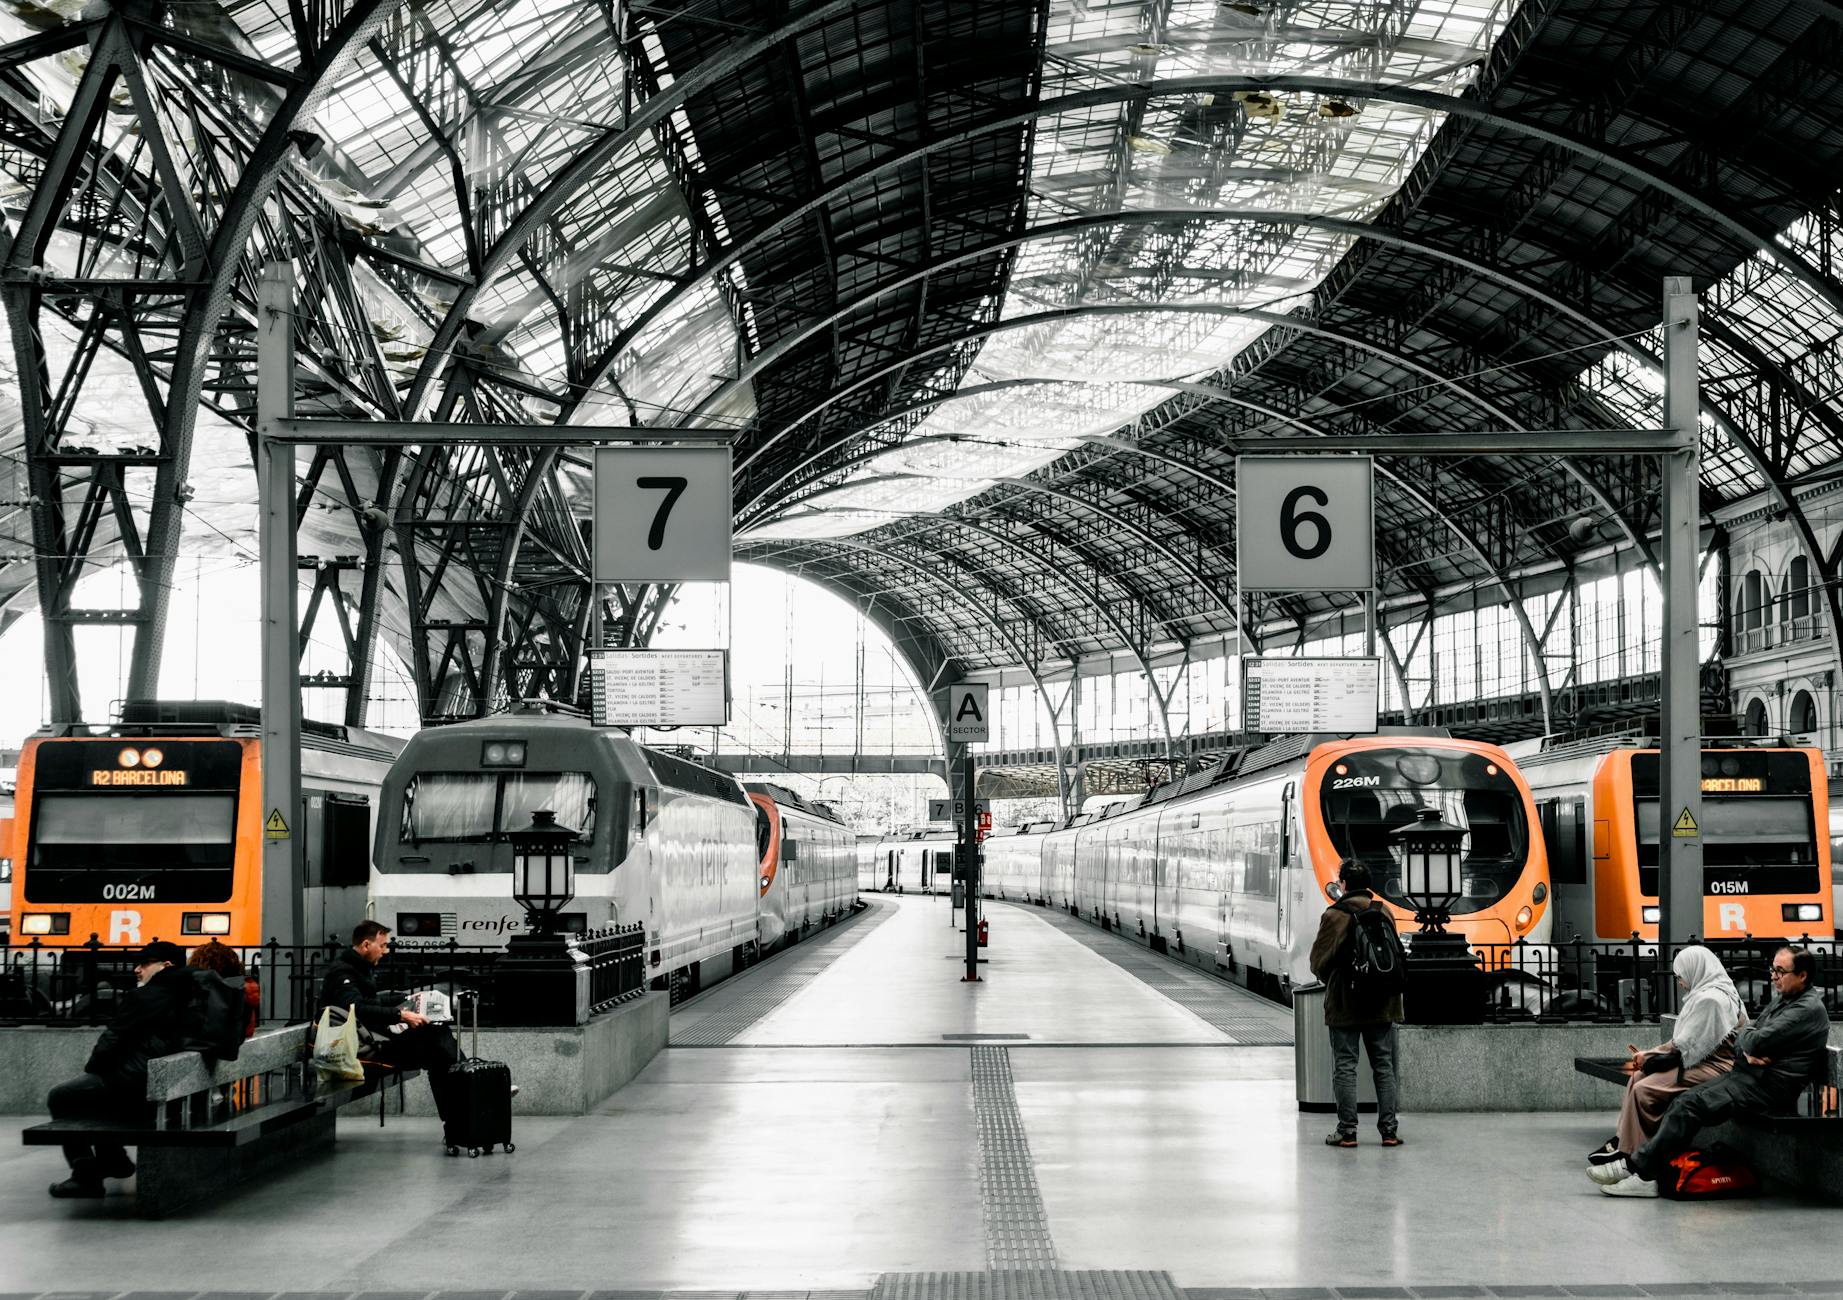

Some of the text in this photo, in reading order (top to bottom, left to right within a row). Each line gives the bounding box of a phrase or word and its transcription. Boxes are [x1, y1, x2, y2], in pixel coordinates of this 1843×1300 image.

[637, 477, 688, 550] 7
[1280, 485, 1332, 559] 6
[956, 692, 982, 722] A
[93, 770, 186, 785] R2 BARCELONA
[1332, 776, 1380, 790] 226M
[936, 804, 944, 816] 7
[955, 803, 964, 813] B
[975, 804, 983, 815] 6
[103, 884, 155, 900] 002M
[1711, 881, 1749, 893] 015M
[1719, 903, 1746, 930] R
[109, 910, 142, 944] R
[462, 915, 519, 936] renfe
